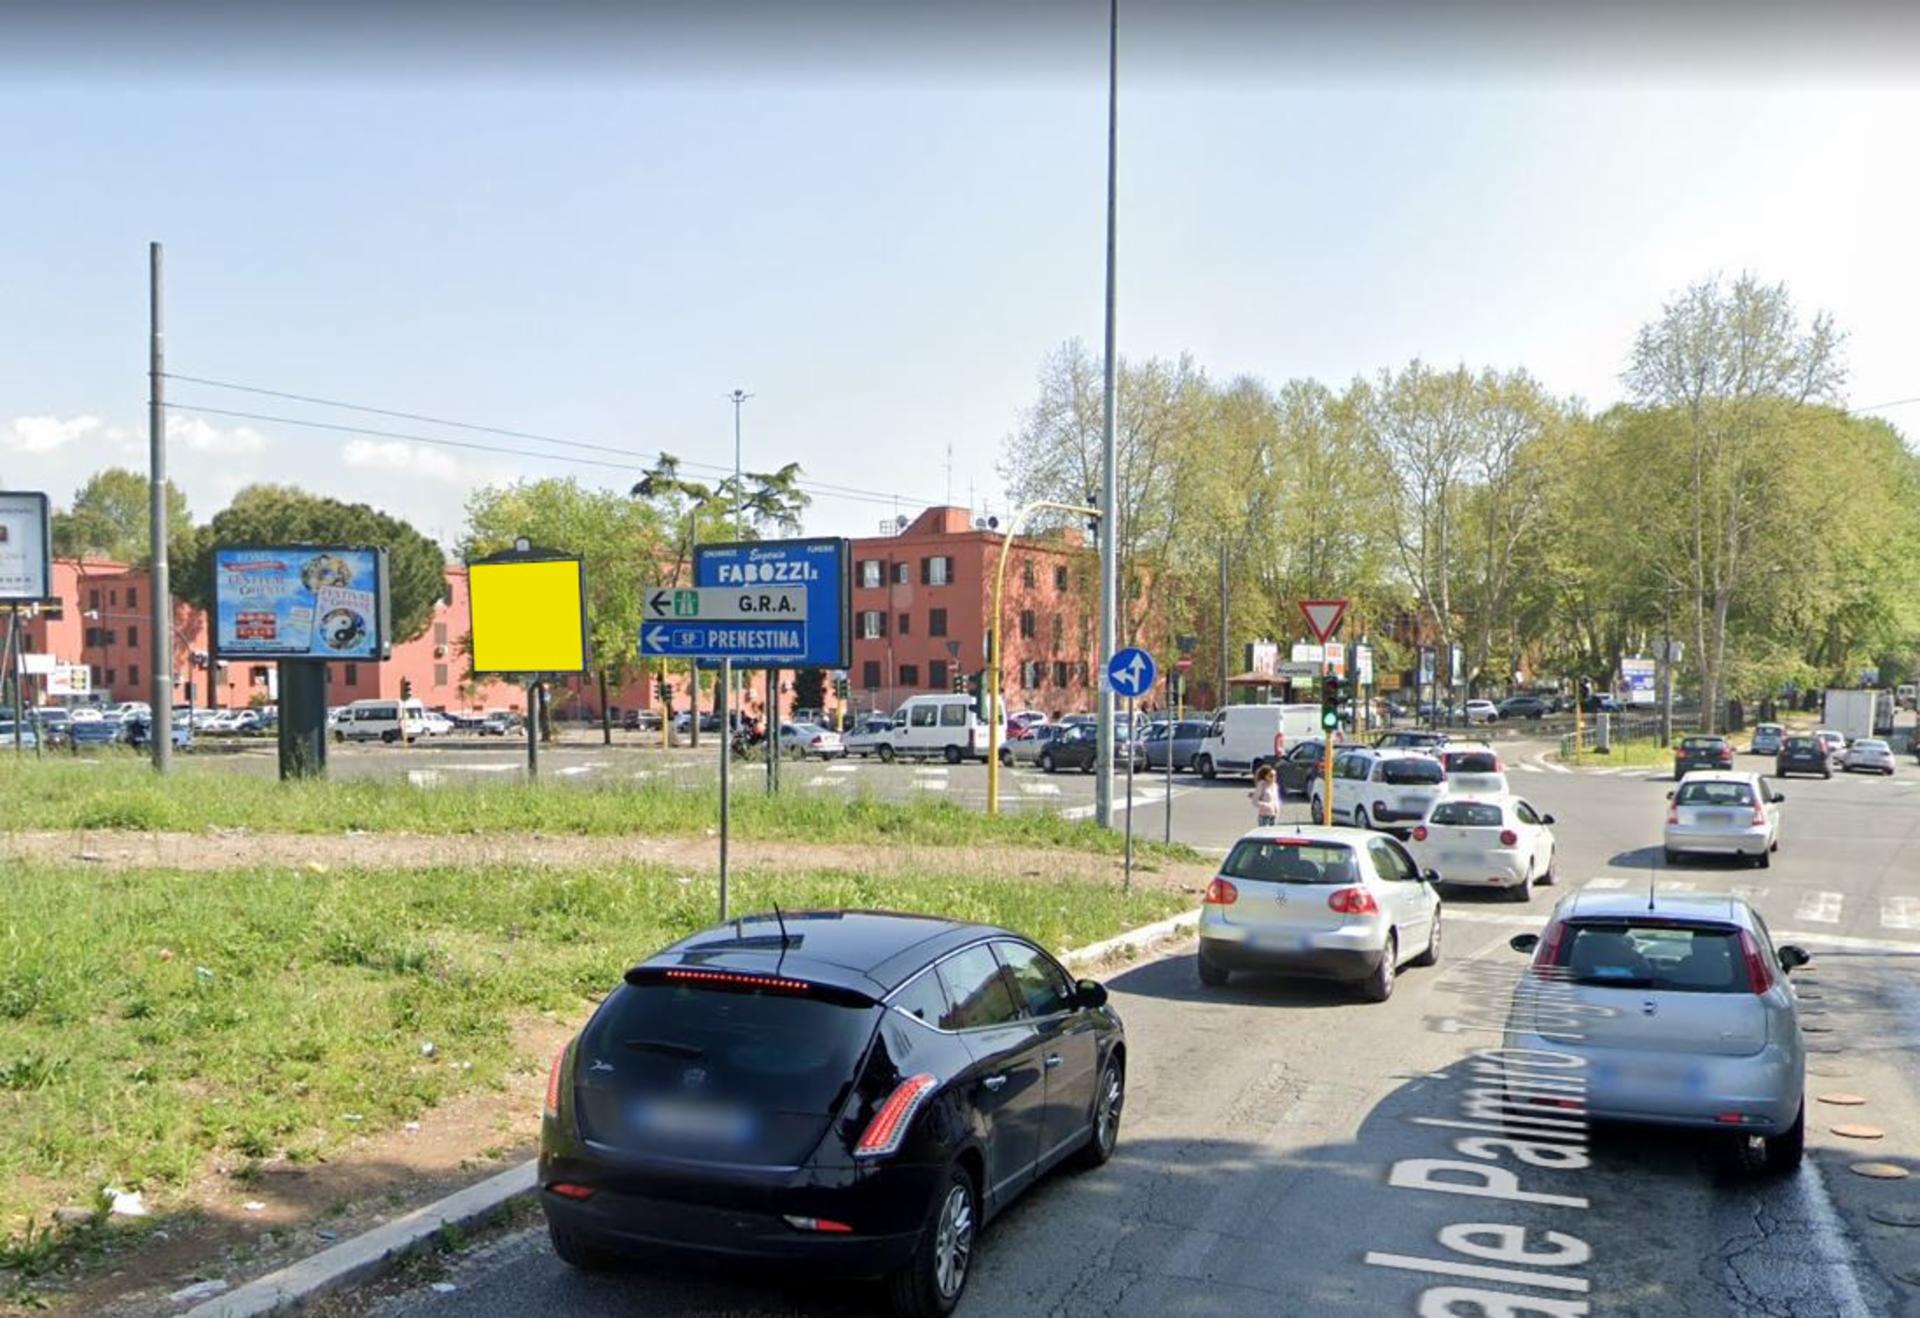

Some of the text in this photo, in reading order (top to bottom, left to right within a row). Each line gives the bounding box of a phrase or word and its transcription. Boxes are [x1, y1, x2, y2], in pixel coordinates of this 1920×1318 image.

[719, 562, 808, 582] FABOZZI
[739, 595, 796, 612] G.R.A.
[681, 630, 799, 648] SP PRENESTINA
